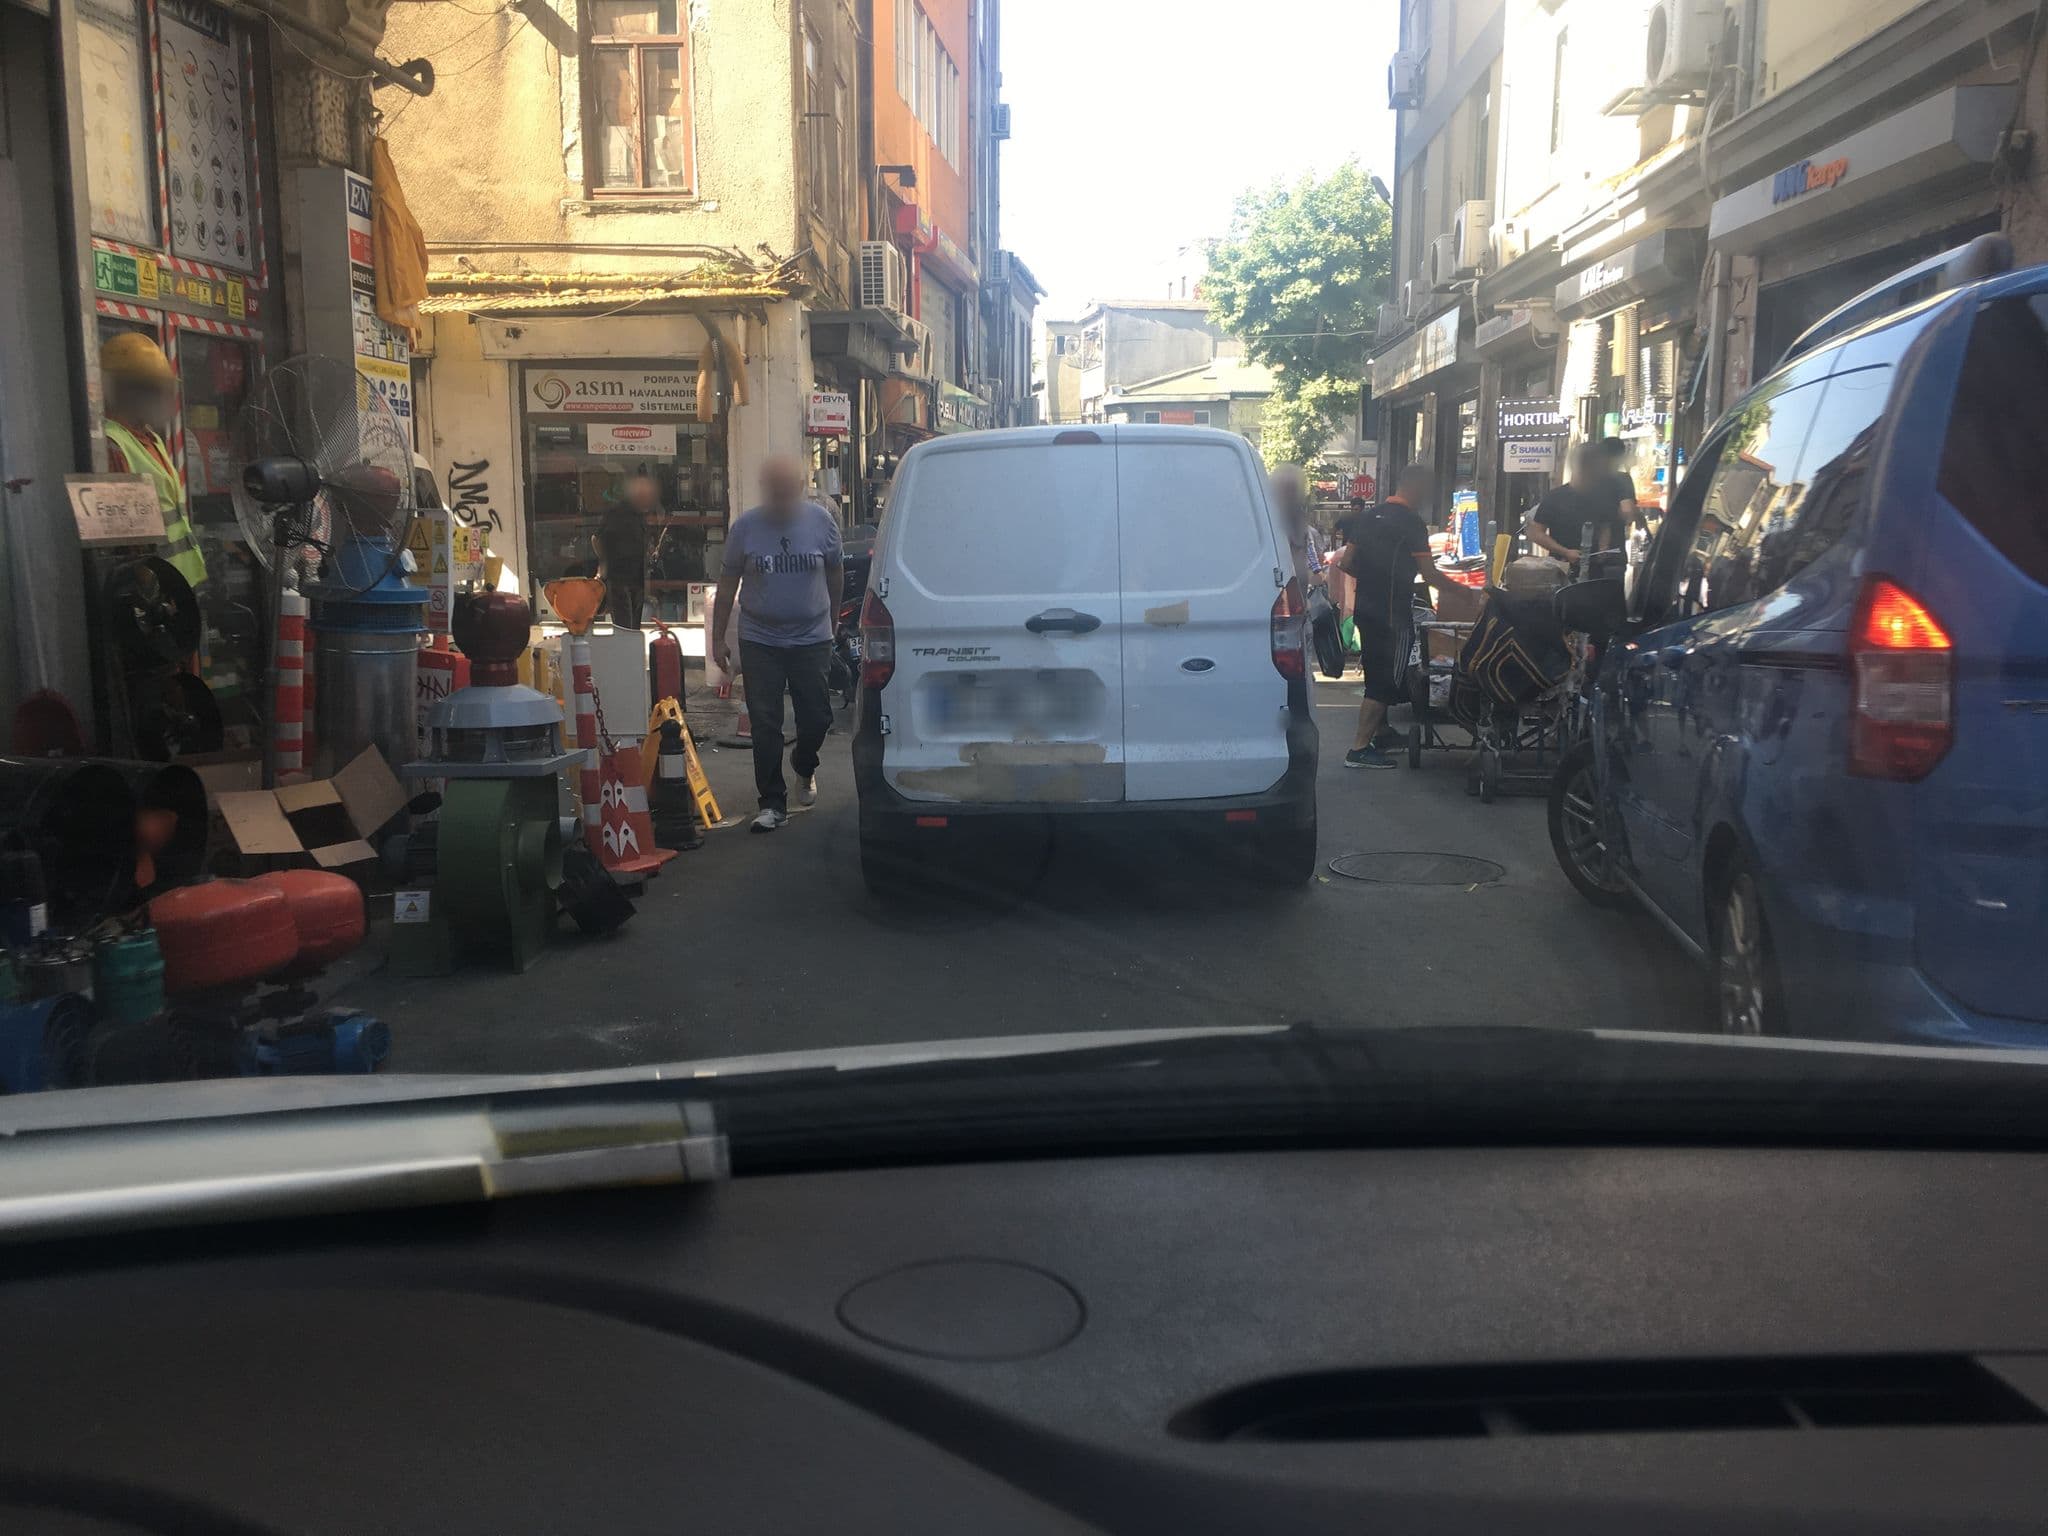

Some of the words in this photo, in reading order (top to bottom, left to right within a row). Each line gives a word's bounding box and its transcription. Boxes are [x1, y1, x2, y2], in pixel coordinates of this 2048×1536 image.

[1806, 156, 1849, 189] kargo
[350, 182, 370, 213] EN
[644, 375, 680, 384] POMPA
[683, 375, 697, 384] VE
[575, 379, 624, 396] asm
[629, 389, 697, 398] HAVALANDIR
[823, 395, 845, 403] BVN
[639, 401, 698, 411] SİSTEMLER
[1519, 446, 1552, 454] SUMAK
[1354, 482, 1374, 493] DUR
[912, 647, 991, 656] TRANSIT
